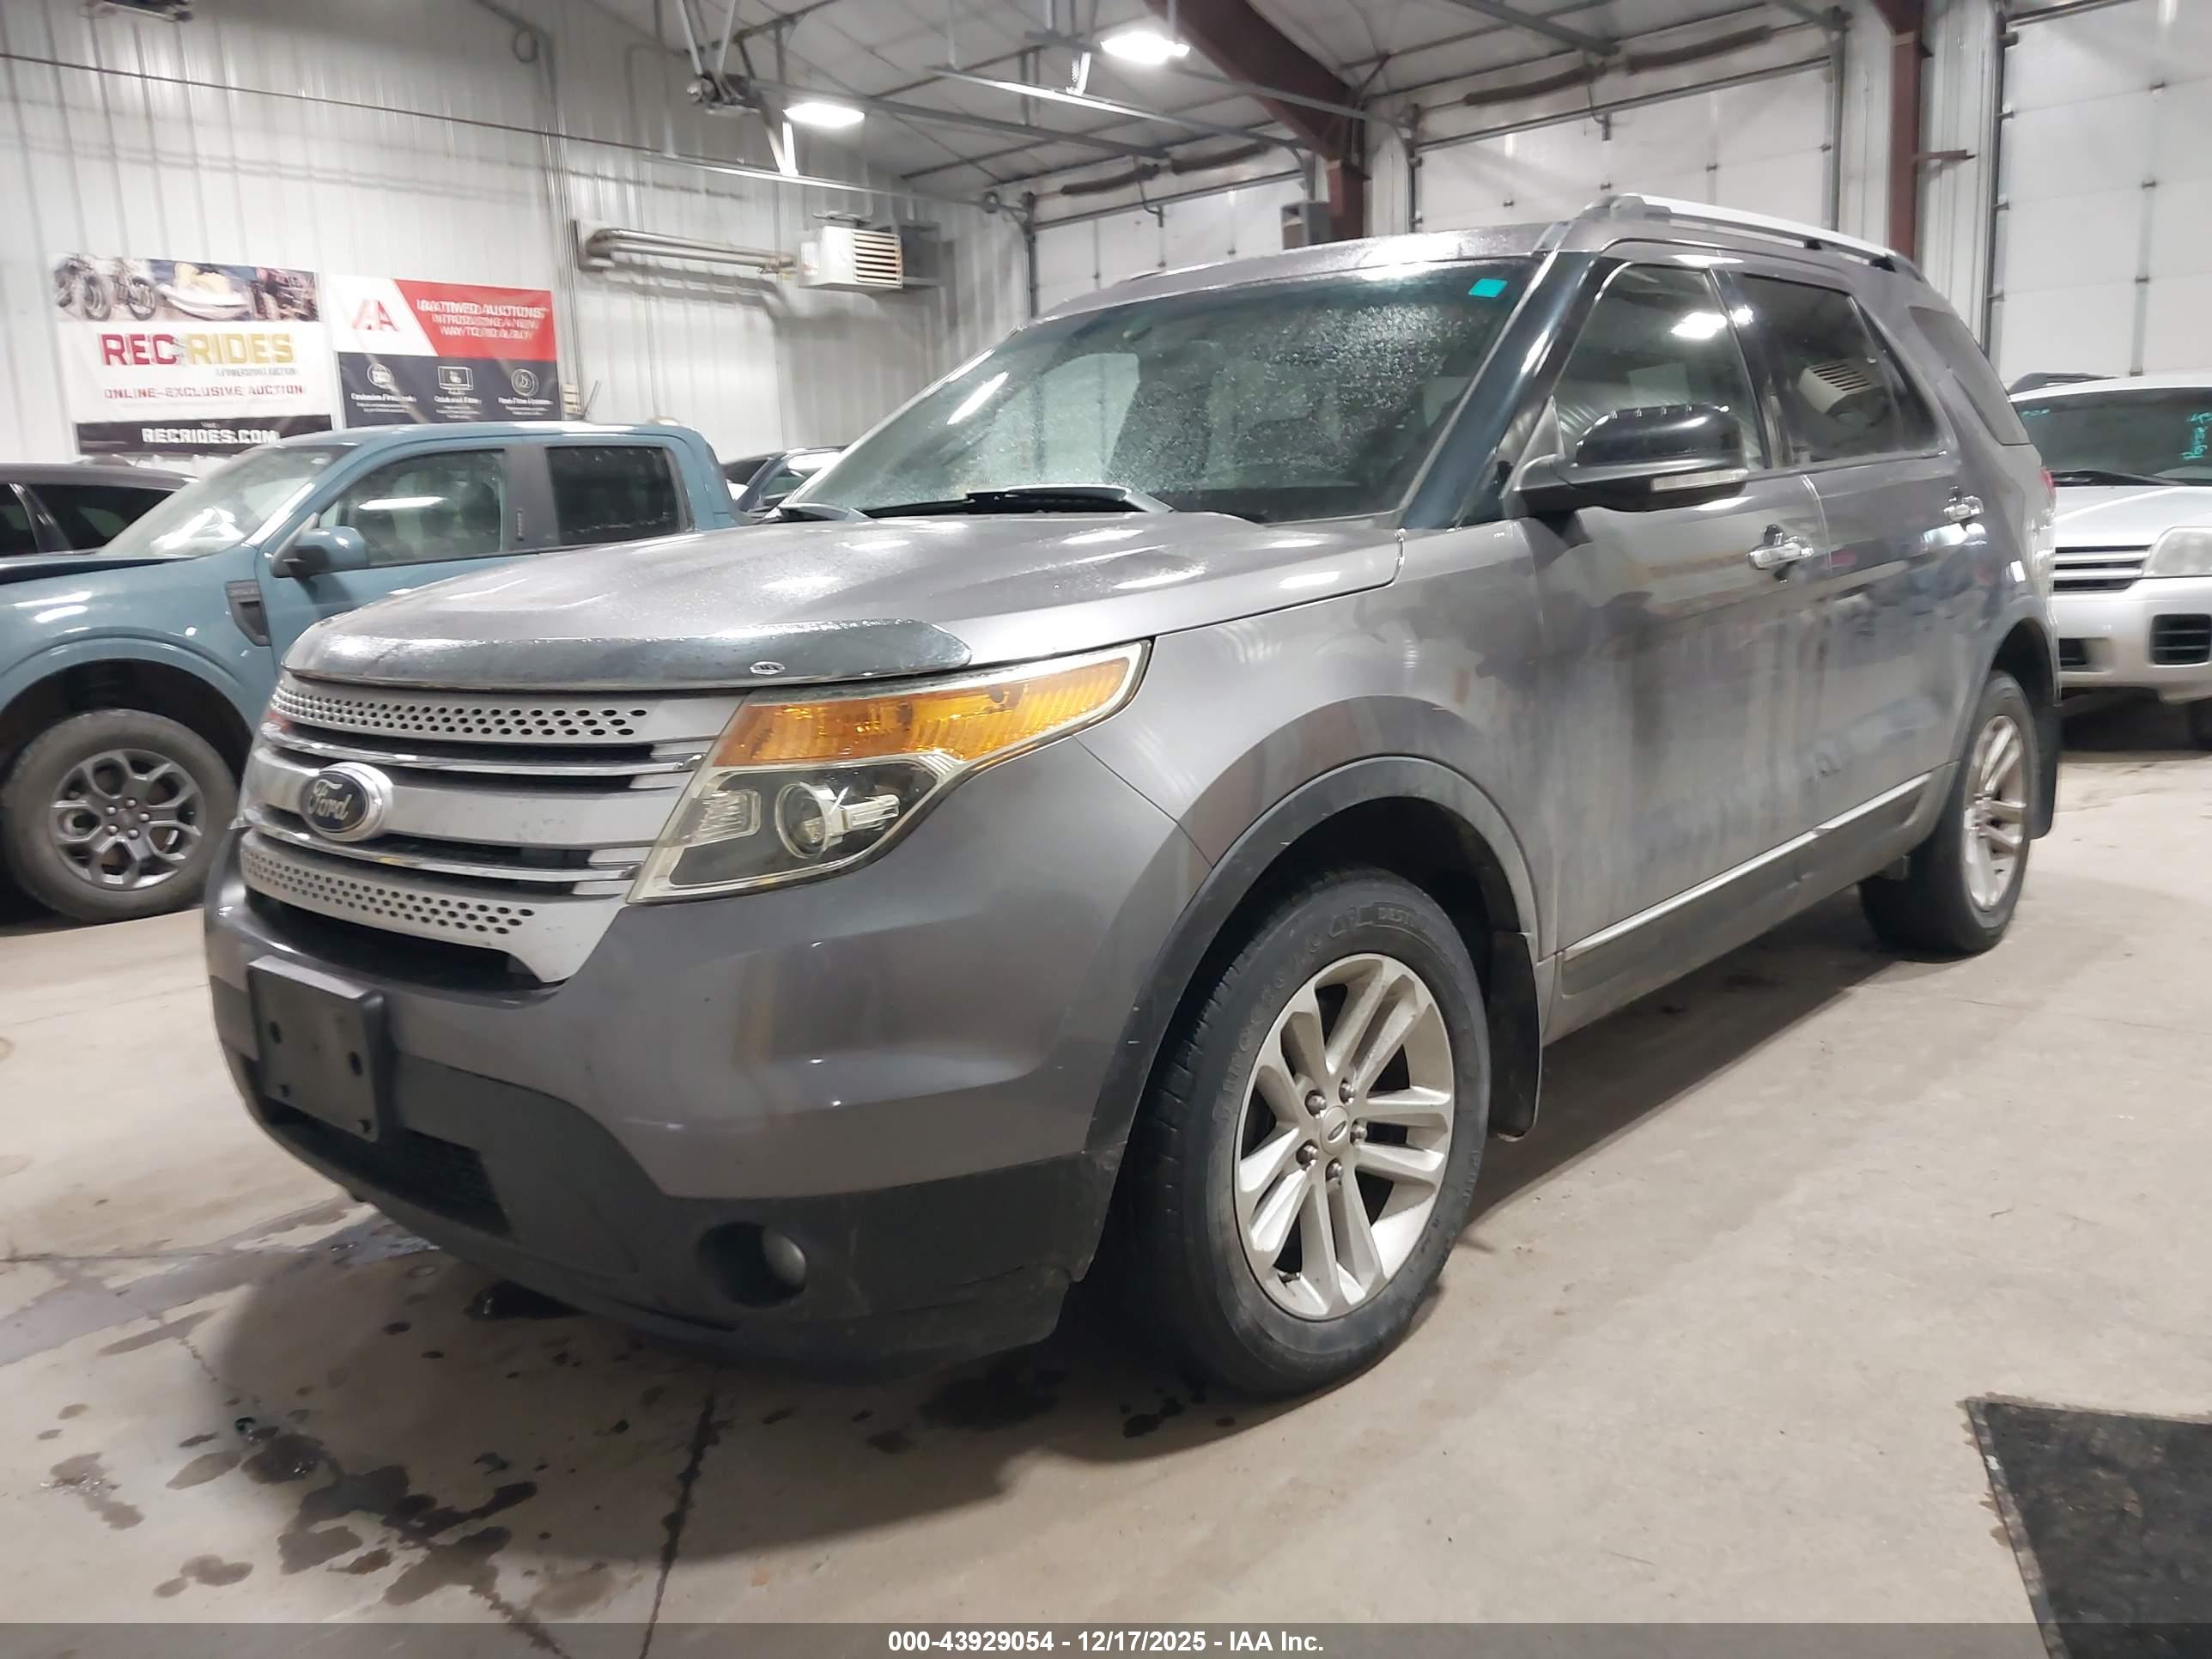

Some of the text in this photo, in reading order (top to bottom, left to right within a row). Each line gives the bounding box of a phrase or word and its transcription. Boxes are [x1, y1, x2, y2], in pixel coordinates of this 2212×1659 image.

[100, 333, 296, 366] REC RIDES
[104, 385, 304, 398] ONLINE-EXCLUSIVE AUCTION
[142, 428, 280, 444] RECRIDES.COM
[307, 779, 352, 820] Ford
